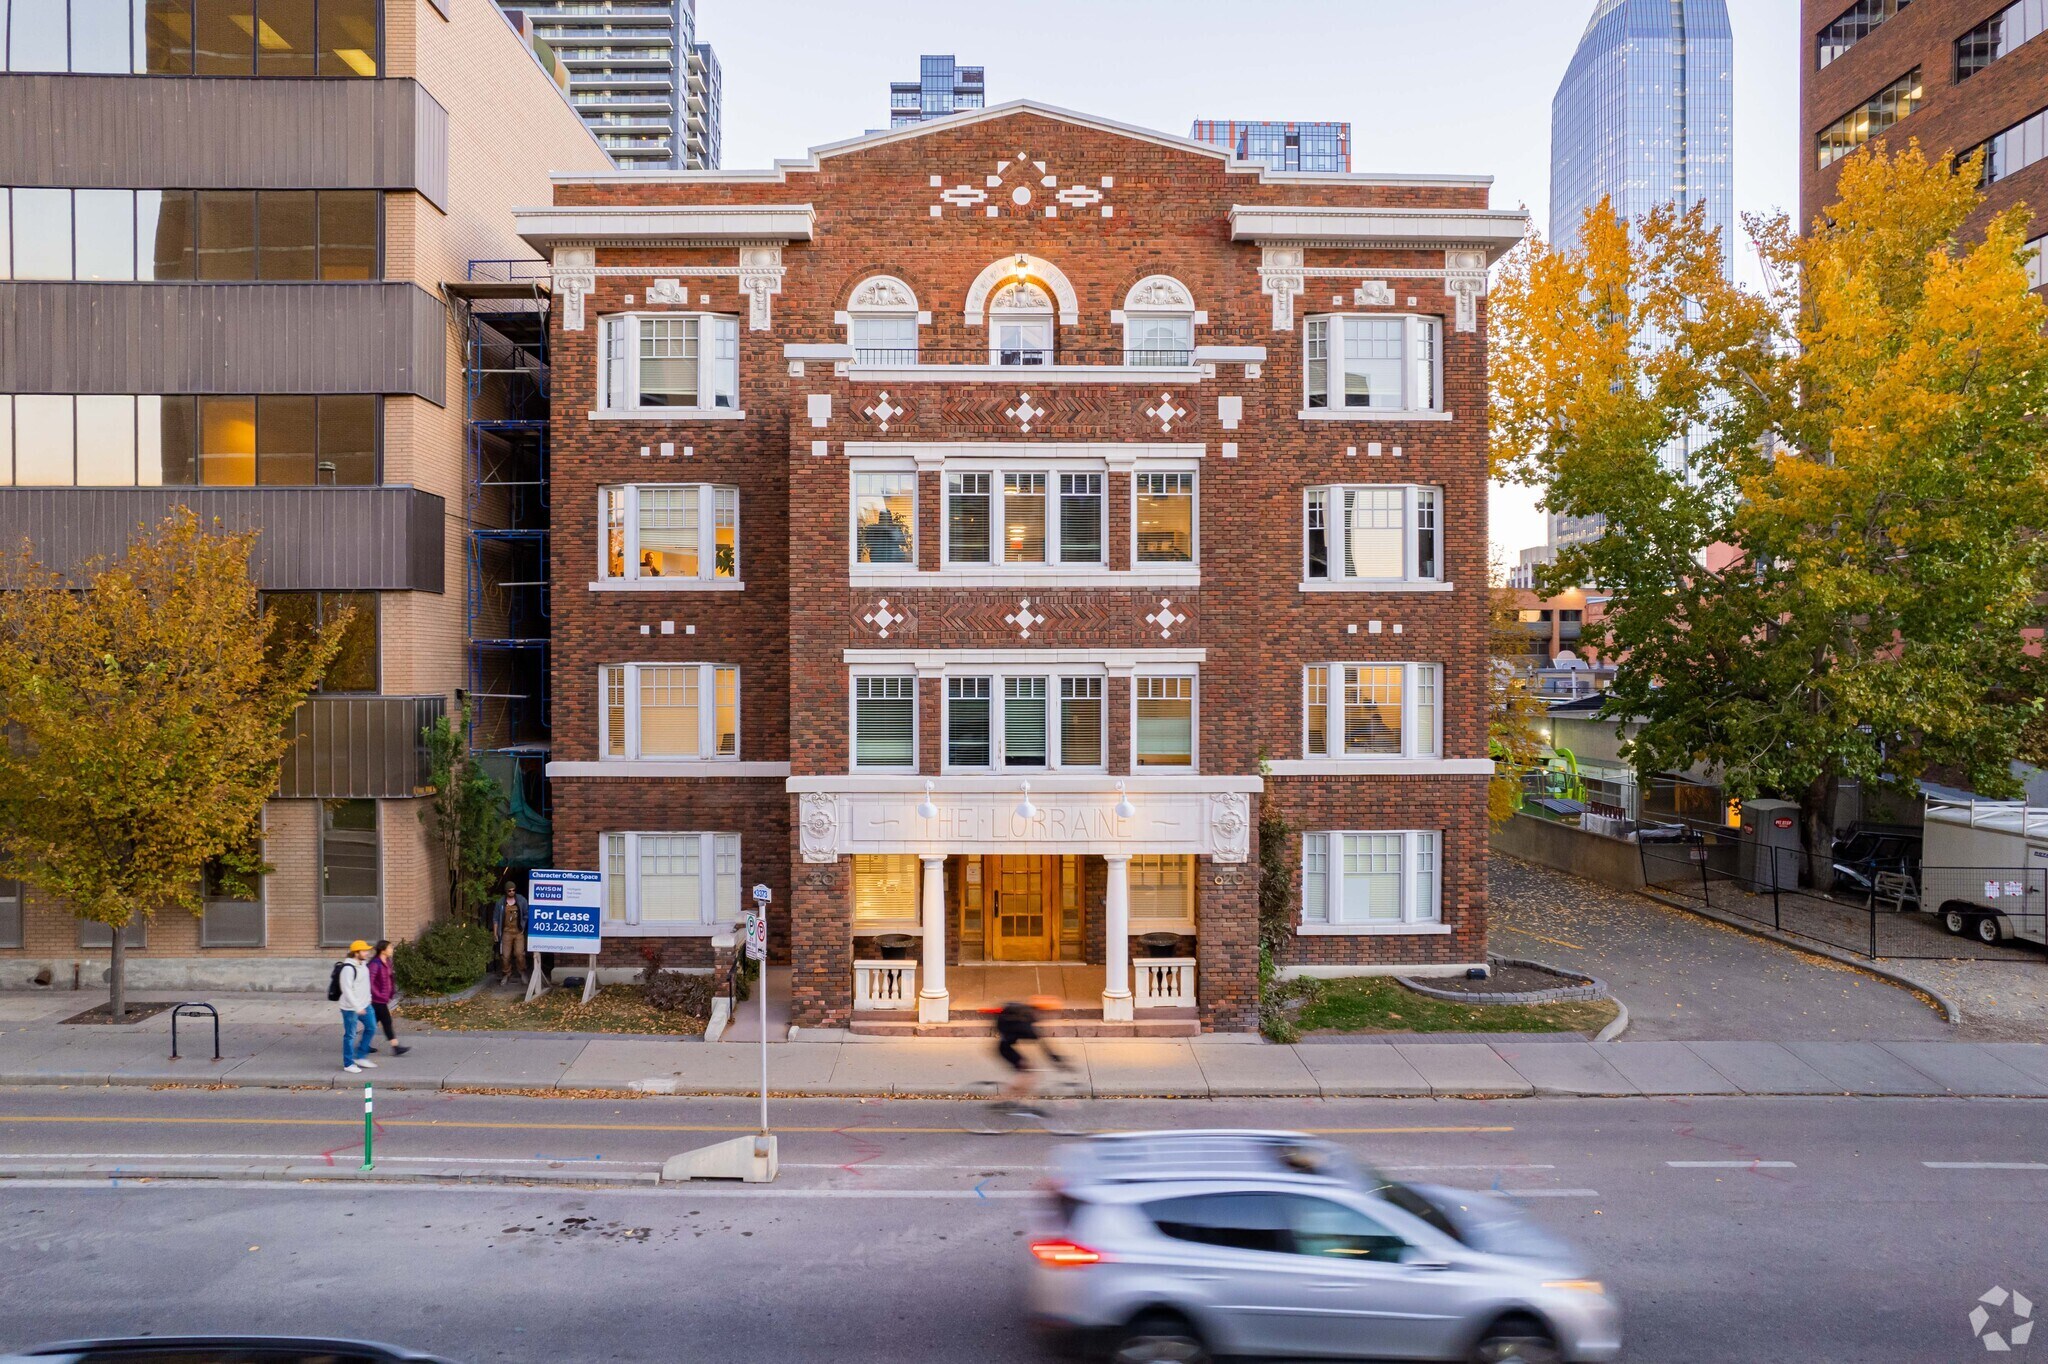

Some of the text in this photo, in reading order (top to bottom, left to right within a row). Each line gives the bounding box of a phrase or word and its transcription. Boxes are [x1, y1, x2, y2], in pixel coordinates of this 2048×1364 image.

[991, 808, 1132, 838] LORRAINE
[532, 871, 598, 881] Character Office Space
[533, 909, 590, 921] For Lease
[533, 922, 595, 933] 403.262.3082
